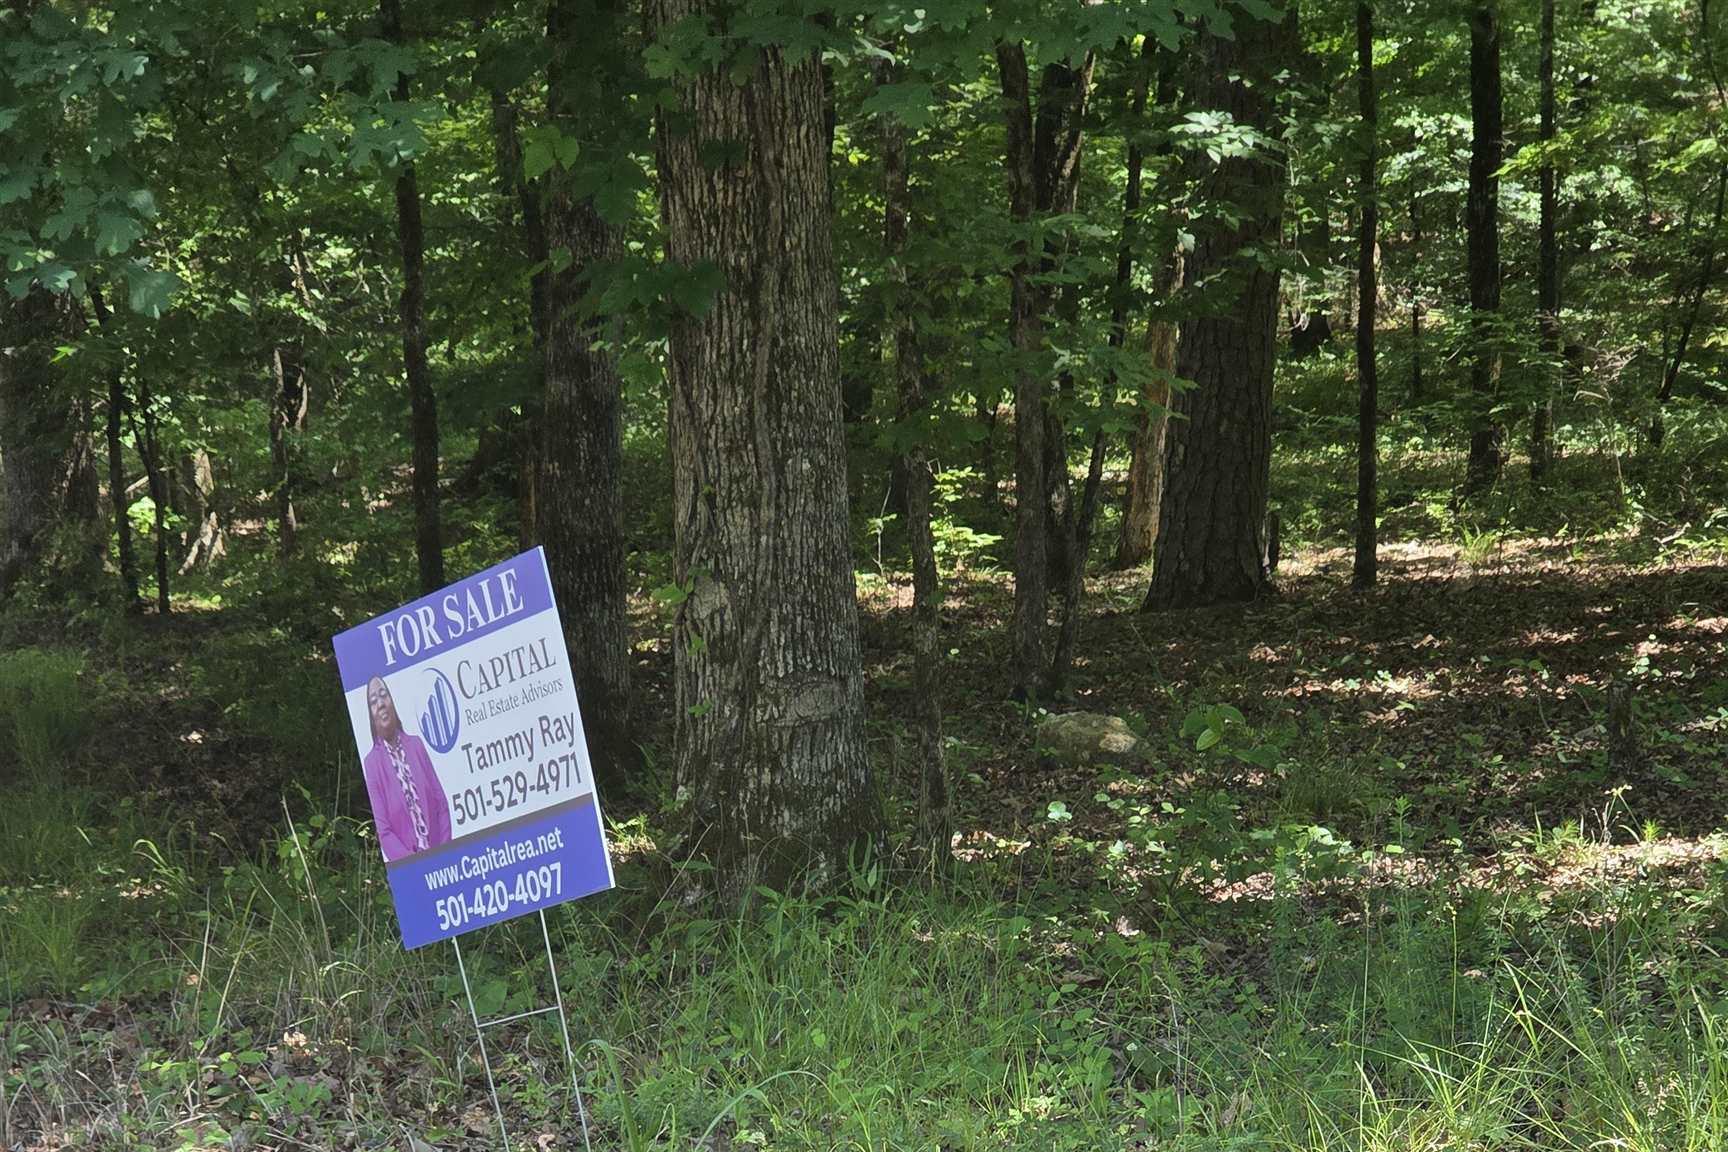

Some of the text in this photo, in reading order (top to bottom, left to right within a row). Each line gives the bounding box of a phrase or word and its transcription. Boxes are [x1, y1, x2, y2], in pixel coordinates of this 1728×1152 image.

[377, 568, 524, 666] FOR SALE
[457, 637, 556, 700] CAPITAL
[464, 677, 564, 726] Real Estate Advisors
[461, 712, 576, 774] Tammy Ray
[452, 752, 582, 825] 501-529-4971
[424, 826, 564, 891] www.Capitalrea.net
[435, 862, 563, 932] 501-420-4097
